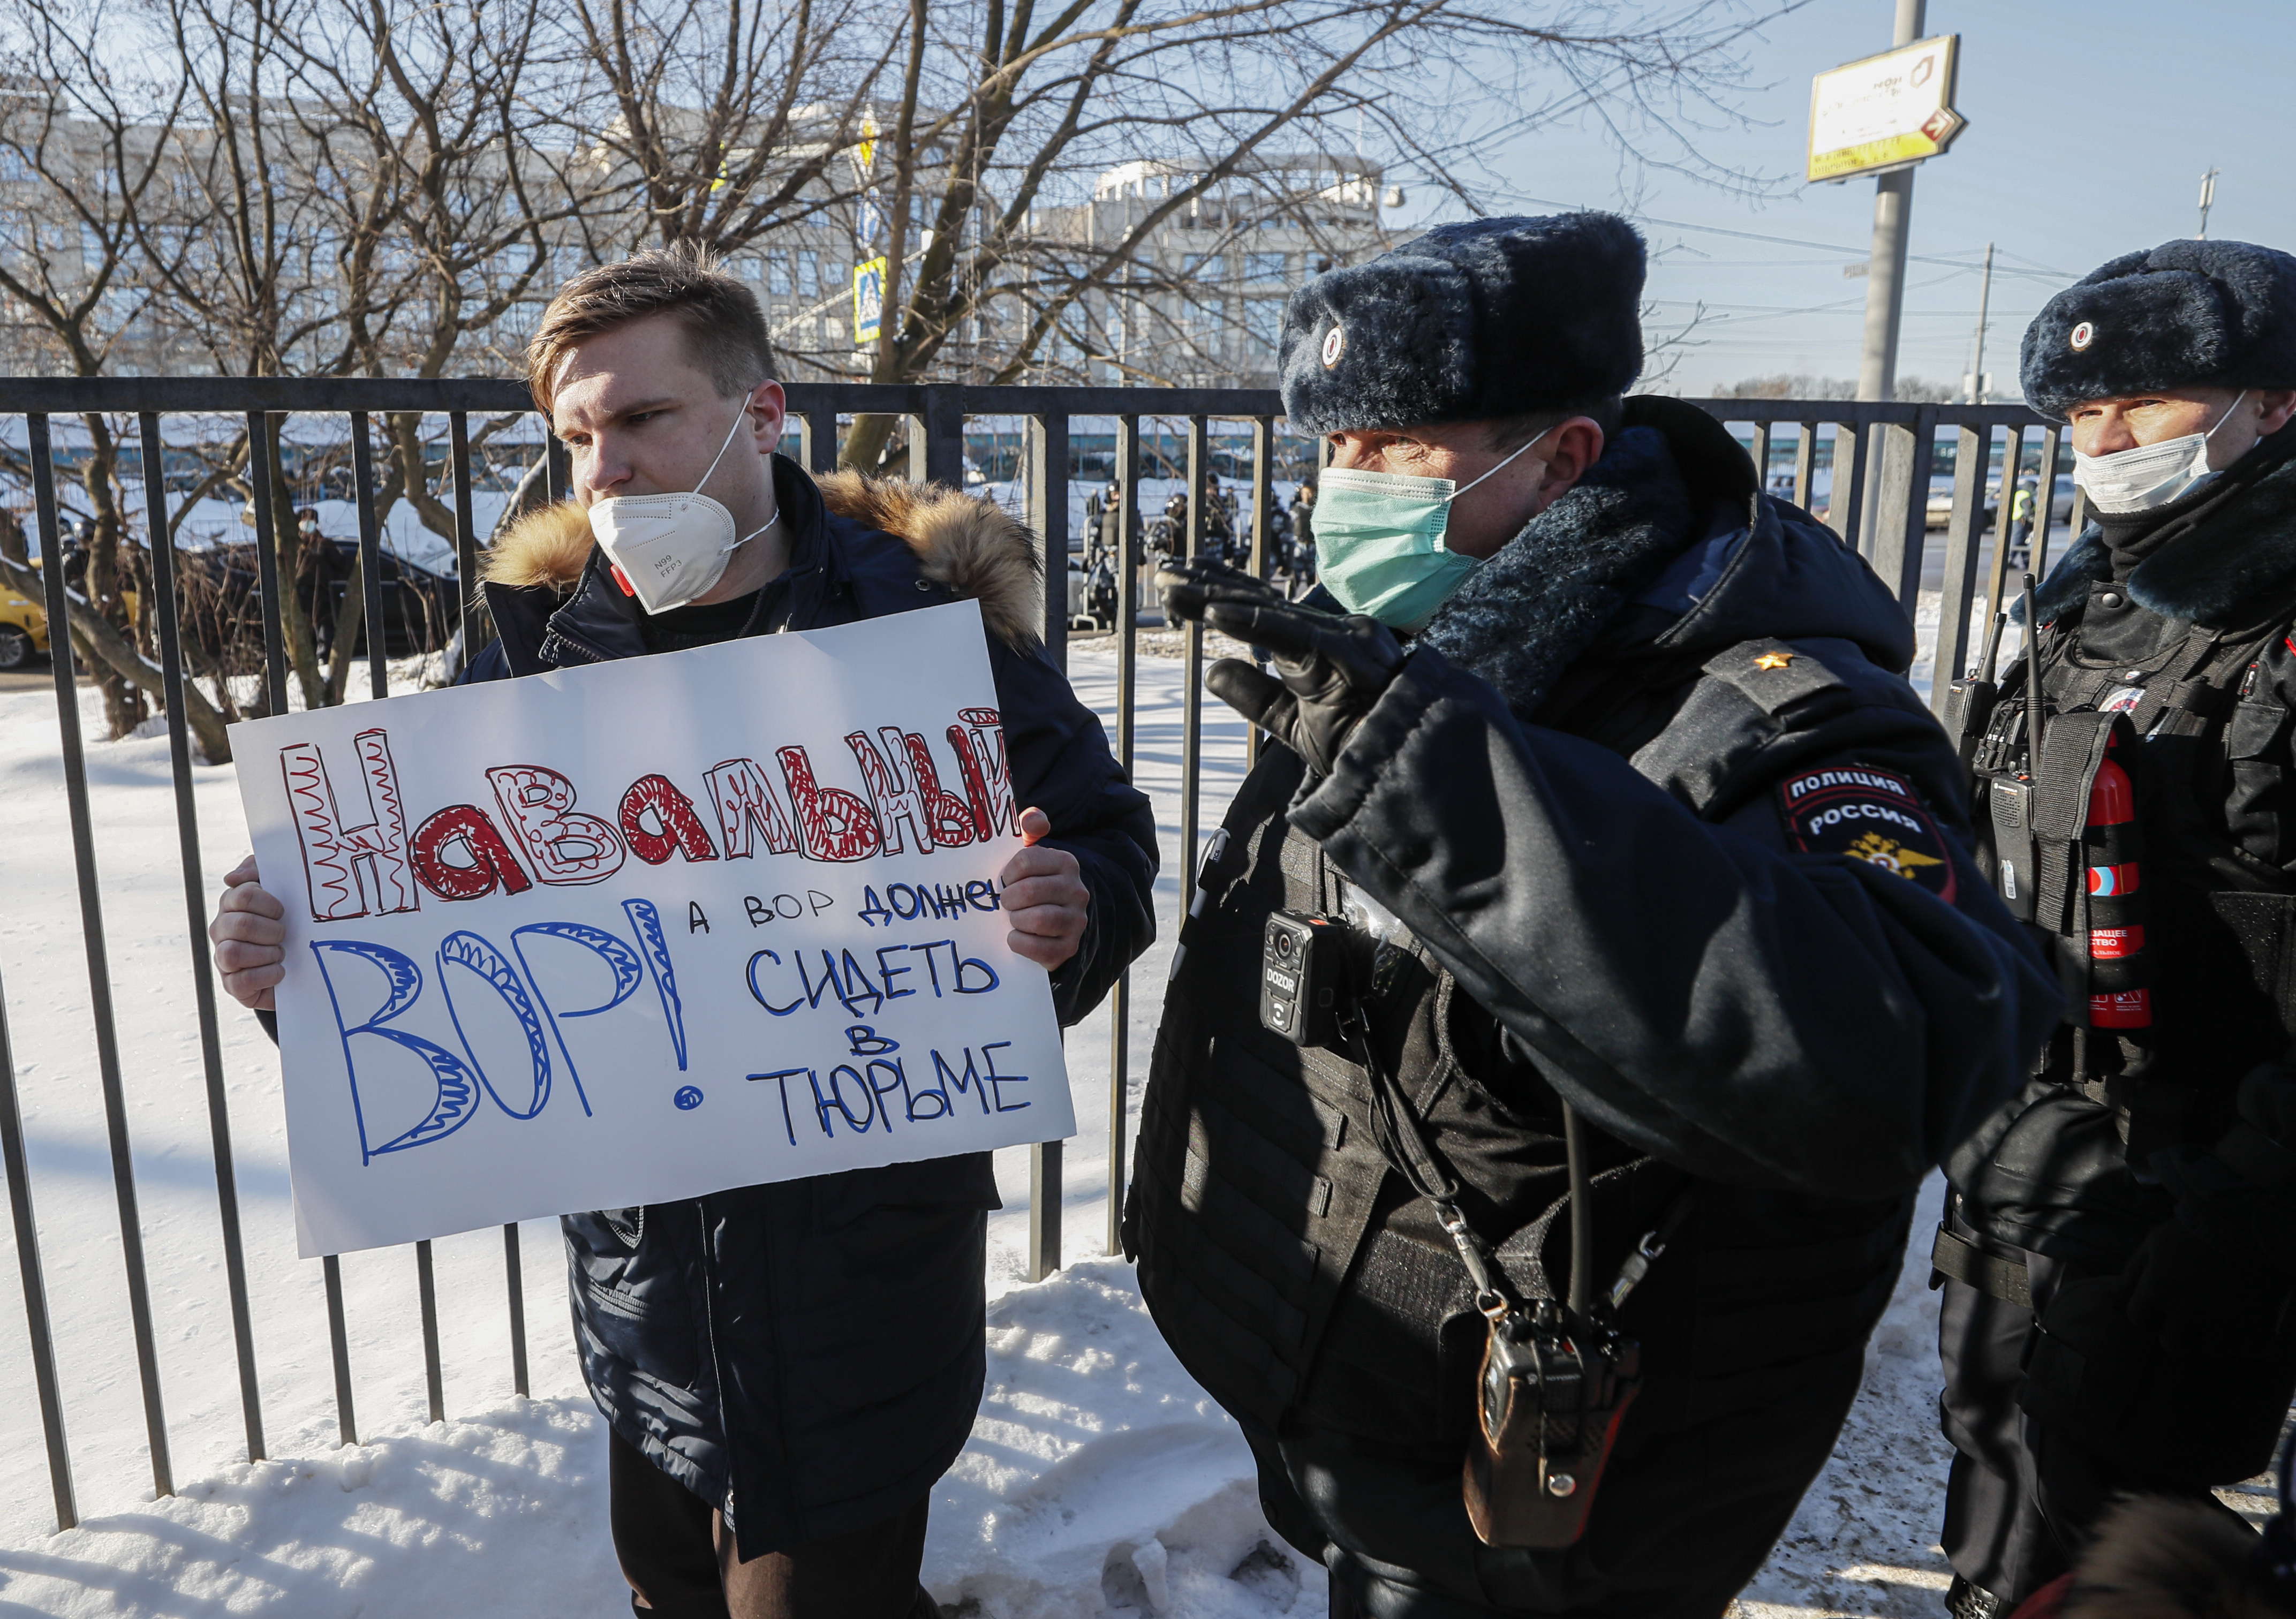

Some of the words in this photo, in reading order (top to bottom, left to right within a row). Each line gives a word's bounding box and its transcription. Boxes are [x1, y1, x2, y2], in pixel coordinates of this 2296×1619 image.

[654, 555, 673, 570] N99
[660, 559, 683, 578] FFP3
[1791, 771, 1906, 798] ПОЛИЦИЯ
[1809, 804, 1922, 835] РОССИЯ
[1212, 849, 1220, 861] ПСБ
[689, 901, 710, 934] А
[744, 890, 834, 928] ВОР
[745, 939, 1000, 1018] СИДЕТЬ
[1266, 967, 1295, 993] DOZOR
[309, 898, 704, 1167] ВОР!
[844, 1025, 901, 1056] В
[745, 1040, 1032, 1146] ТЮРЬМЕ
